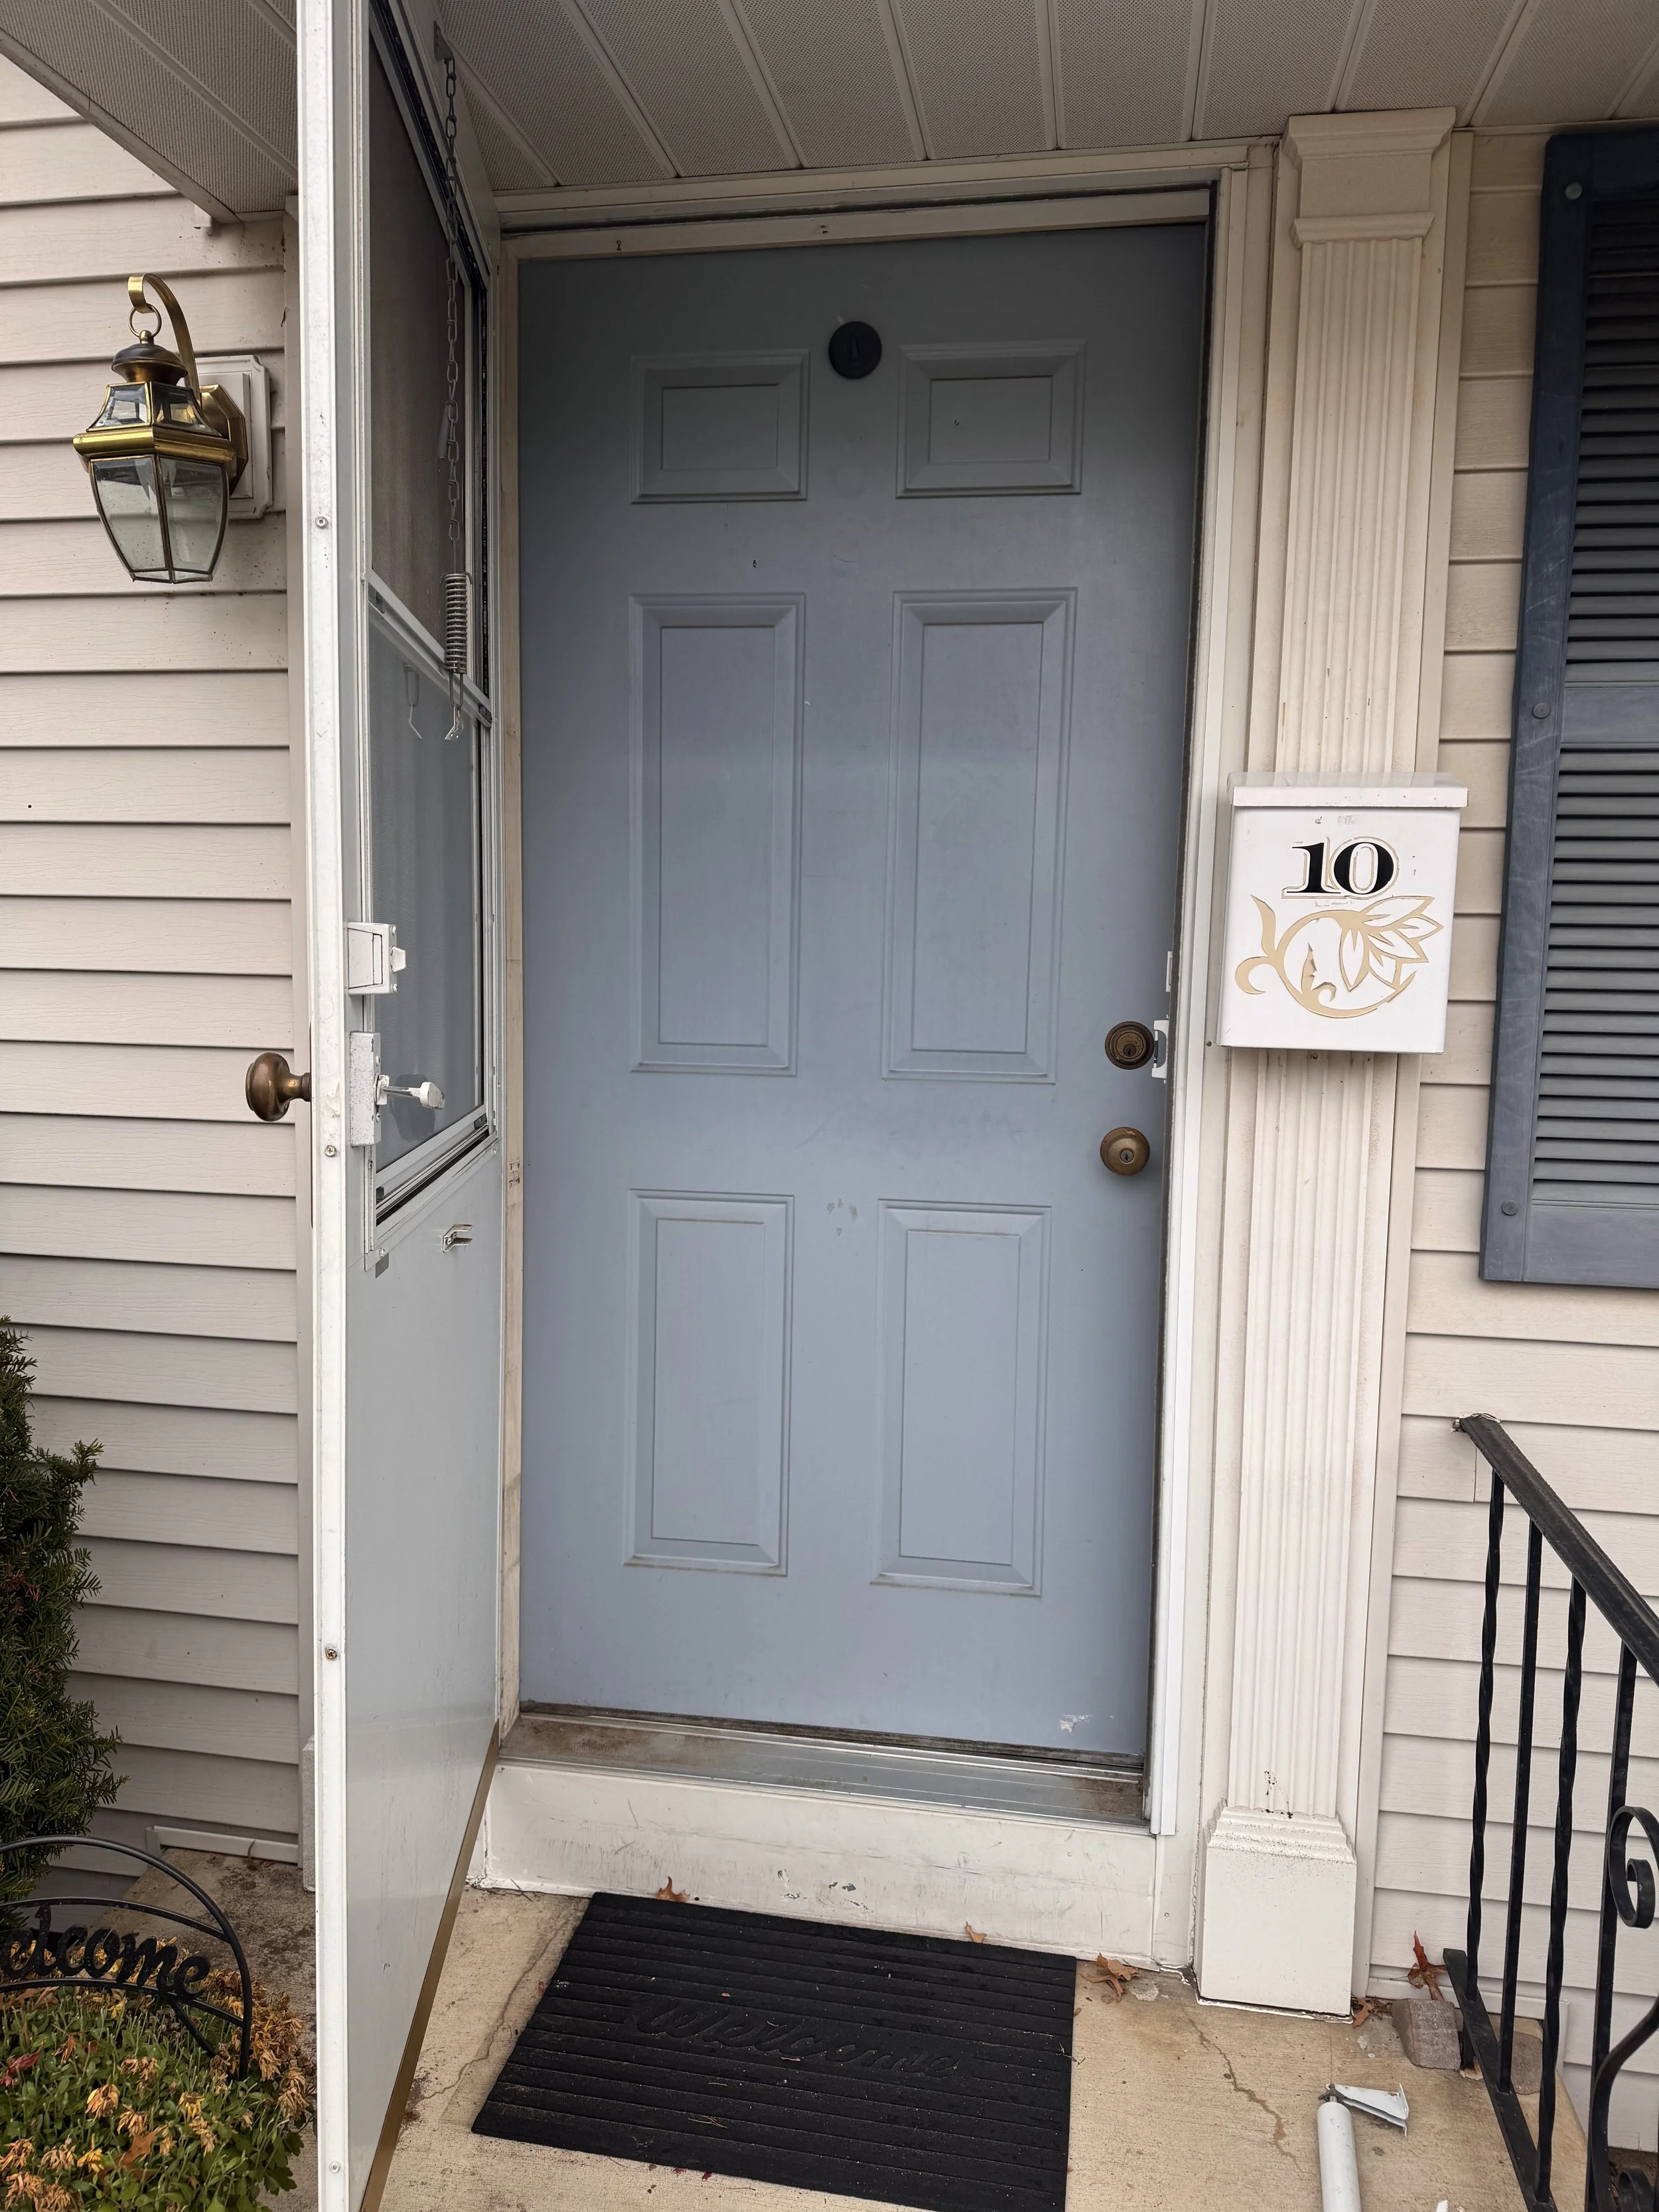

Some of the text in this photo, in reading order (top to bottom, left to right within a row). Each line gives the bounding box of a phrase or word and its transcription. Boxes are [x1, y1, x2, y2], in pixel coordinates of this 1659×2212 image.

[1286, 841, 1395, 895] 10
[0, 1903, 211, 1995] elcome
[636, 1996, 961, 2079] Welcome
